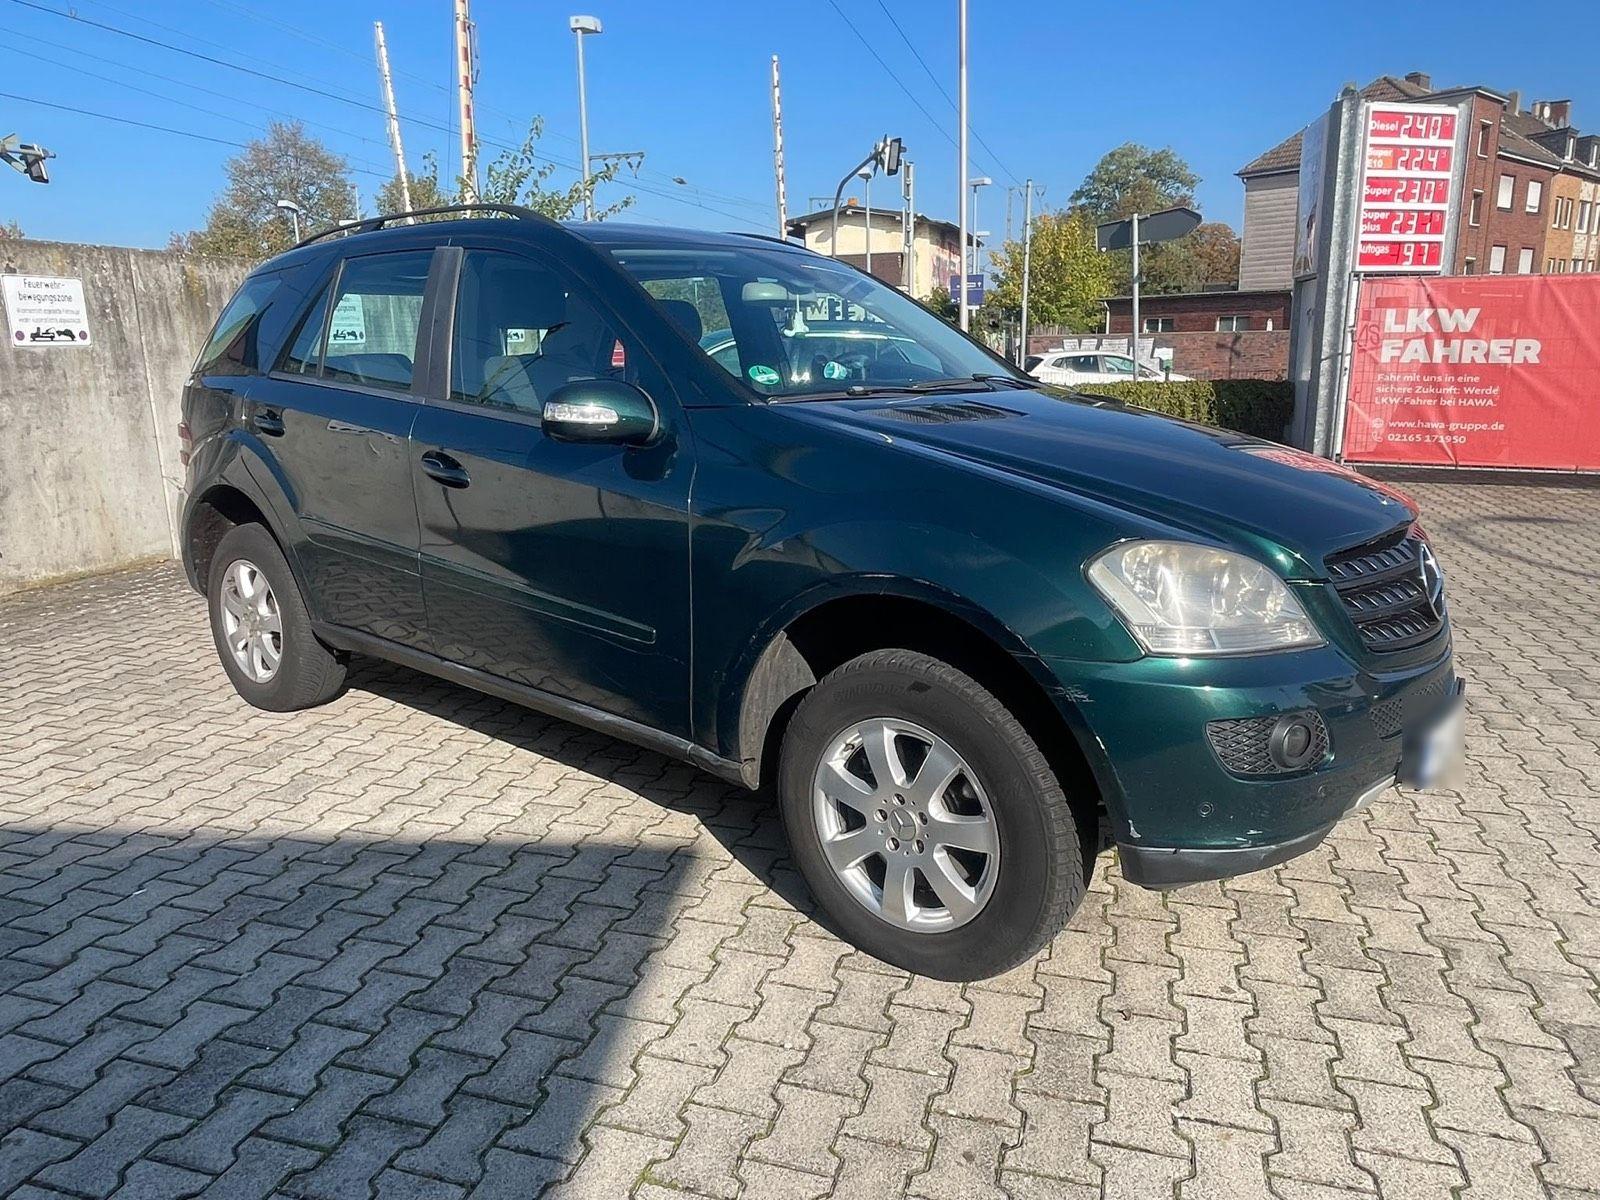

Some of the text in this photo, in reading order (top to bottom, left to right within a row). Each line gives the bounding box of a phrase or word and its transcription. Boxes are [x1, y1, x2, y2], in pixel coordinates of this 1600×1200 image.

[1370, 120, 1399, 131] Diesel
[1367, 149, 1393, 157] Super
[1364, 185, 1393, 197] Super
[1362, 211, 1391, 222] Super
[1361, 222, 1381, 234] plus
[23, 278, 66, 289] Feuerwehr-
[18, 291, 73, 304] bewegungszone
[1384, 307, 1481, 334] LKW
[1380, 338, 1542, 364] FAHRER
[1377, 373, 1480, 383] Fahr mit uns in eine
[1375, 384, 1413, 394] sichere
[1463, 386, 1500, 396] Werde
[1375, 397, 1497, 407] LKW-Fahrer bei HAWA.
[1388, 419, 1505, 432] www.hawa-gruppe.de
[1387, 433, 1422, 442] 02165
